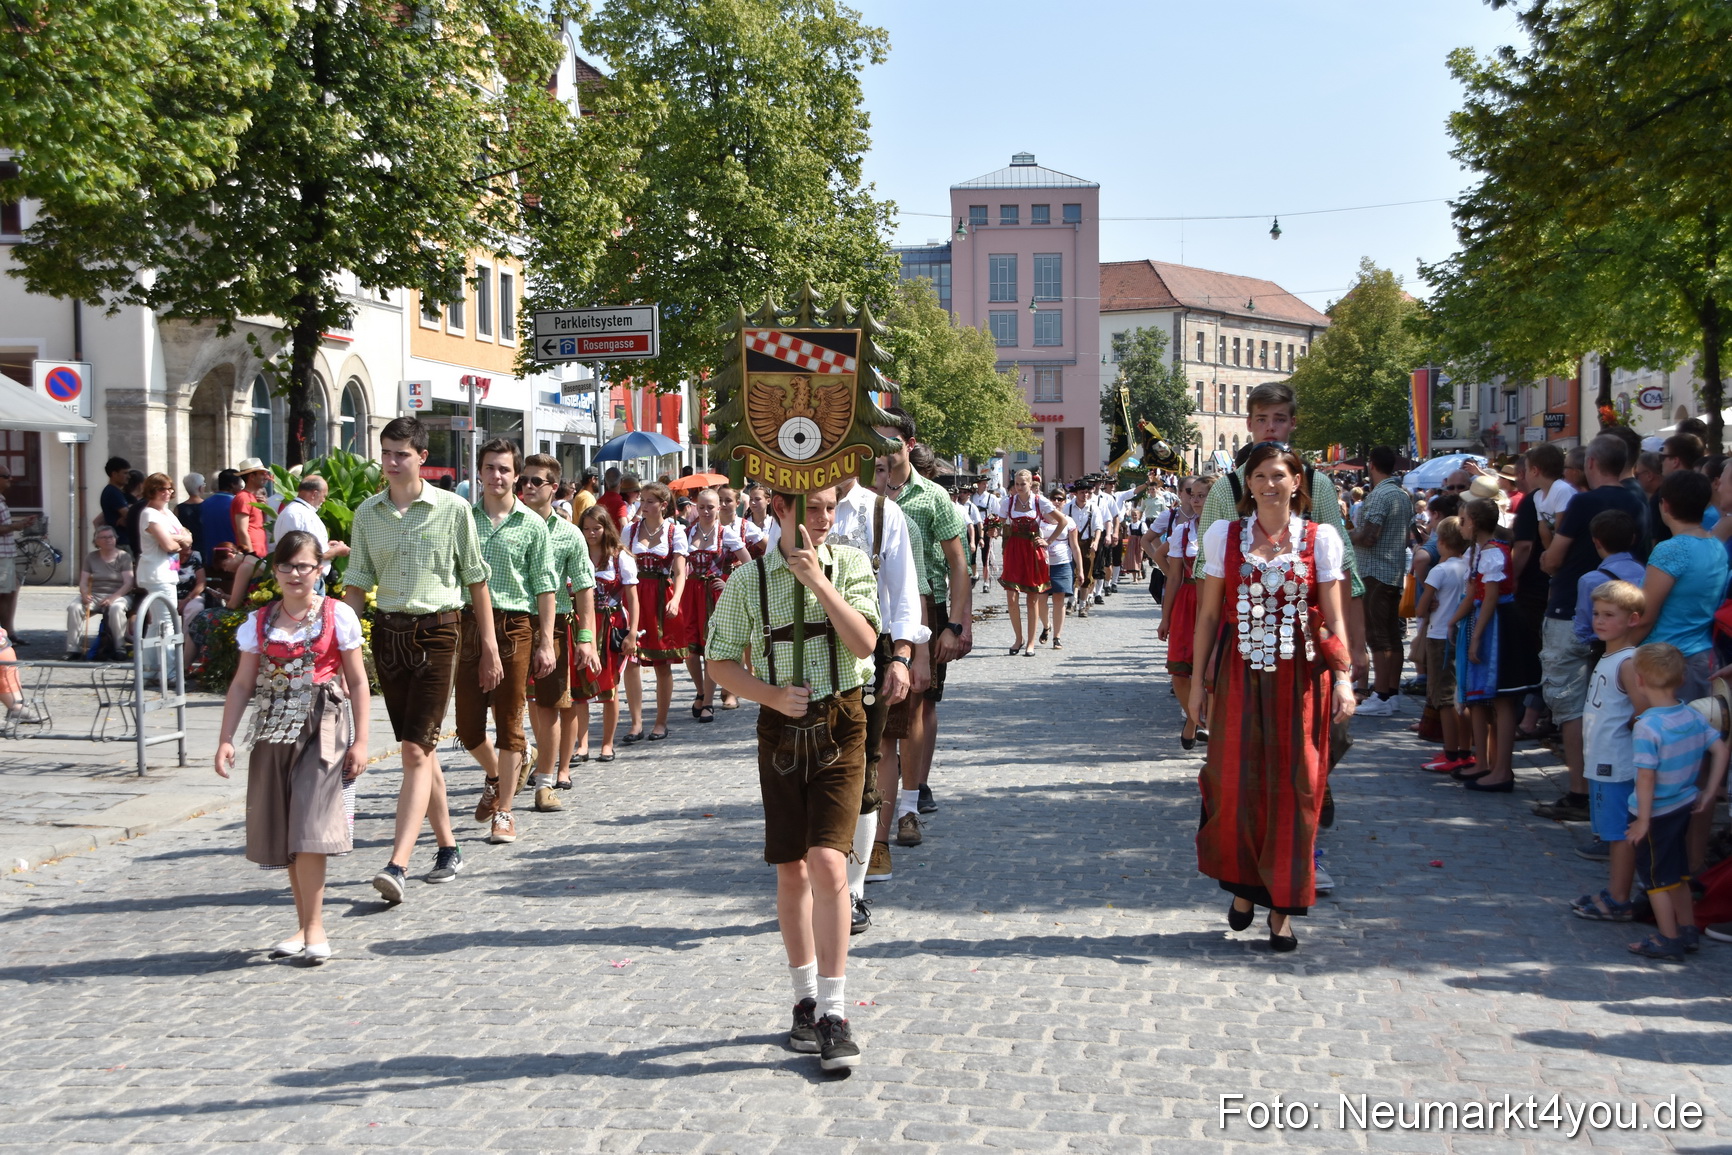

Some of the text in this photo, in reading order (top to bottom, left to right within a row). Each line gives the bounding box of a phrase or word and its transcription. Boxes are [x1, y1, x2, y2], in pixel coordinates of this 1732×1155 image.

[554, 315, 633, 331] Parkleitsystem
[564, 339, 635, 354] P Rosengasse
[563, 382, 592, 393] Rosengasse
[1643, 393, 1663, 404] C&A
[1545, 414, 1564, 422] MATT
[748, 452, 856, 490] BERNGAU
